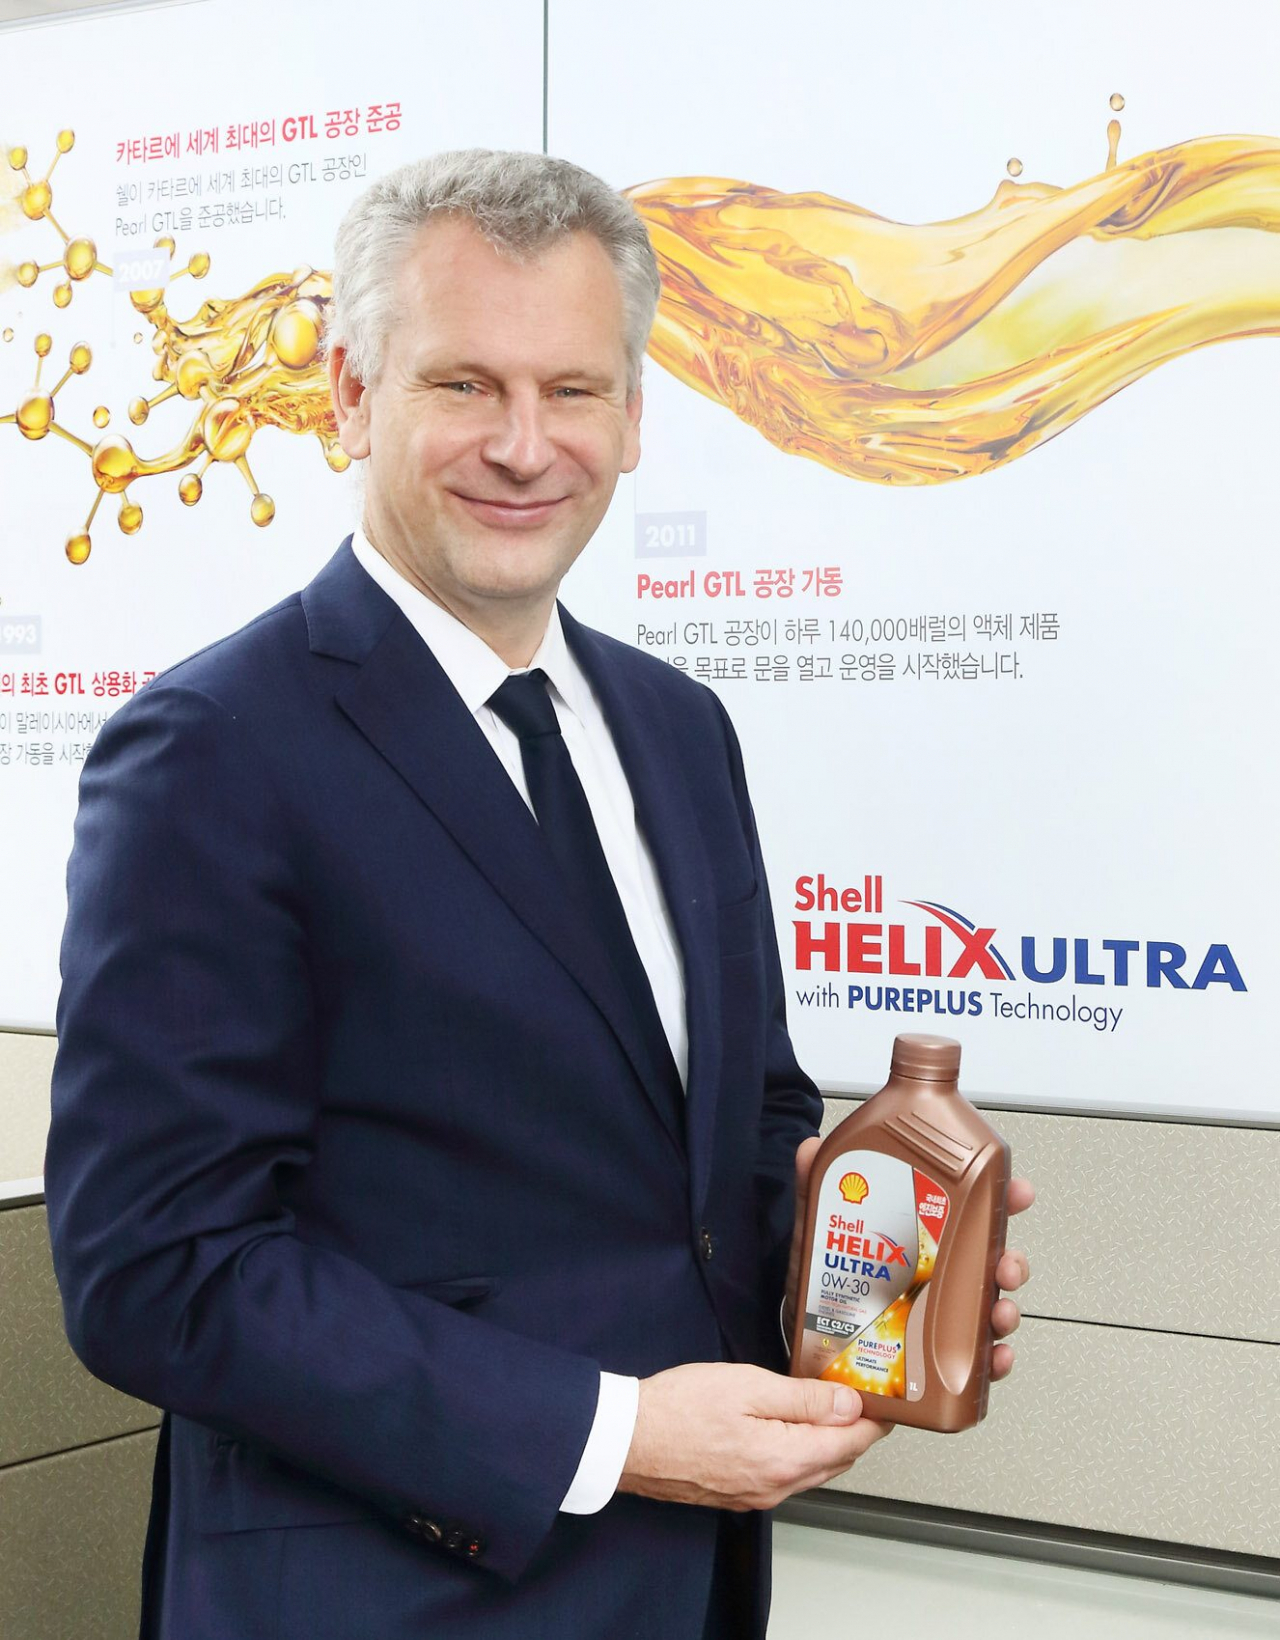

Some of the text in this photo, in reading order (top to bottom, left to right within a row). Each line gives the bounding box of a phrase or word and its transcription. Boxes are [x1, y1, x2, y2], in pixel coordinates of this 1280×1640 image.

[117, 102, 402, 165] 카타르에 세계 최대의 GTL 공장 준공
[116, 153, 366, 207] 쉘이 카타르에 세계 최대의 GTL 공장인
[116, 196, 286, 236] Pearl GTL을 준공했습니다.
[119, 259, 165, 283] 2007
[645, 524, 695, 548] 2011
[637, 567, 843, 599] Pearl GTL 공장 가동
[0, 624, 36, 645] 993
[637, 612, 1060, 646] Pearl GTL 공장이 하루 140,000배럴의 액체 제품
[694, 656, 748, 682] 목표로
[754, 654, 790, 682] 문을
[796, 654, 833, 682] 열고
[839, 653, 896, 682] 운영을
[902, 651, 1024, 681] 시작했습니다.
[20, 672, 50, 697] 최초
[55, 672, 85, 695] GTL
[92, 671, 137, 697] 상용화
[16, 711, 107, 735] 말레이시아에서
[16, 742, 55, 766] 가동을
[794, 873, 883, 913] Shell
[792, 903, 1248, 992] HELIX ULTRA
[796, 983, 1123, 1032] with PUREPLUS Technology
[829, 1214, 864, 1234] Shell
[826, 1231, 907, 1267] HELIX
[824, 1253, 891, 1282] ULTRA
[821, 1271, 870, 1296] 0W-30
[817, 1316, 831, 1326] ECT
[831, 1320, 855, 1333] C2/C3
[857, 1347, 896, 1360] TECHNOLOGY
[858, 1339, 897, 1354] PUREPLUS
[855, 1361, 889, 1373] PERFORMANCE
